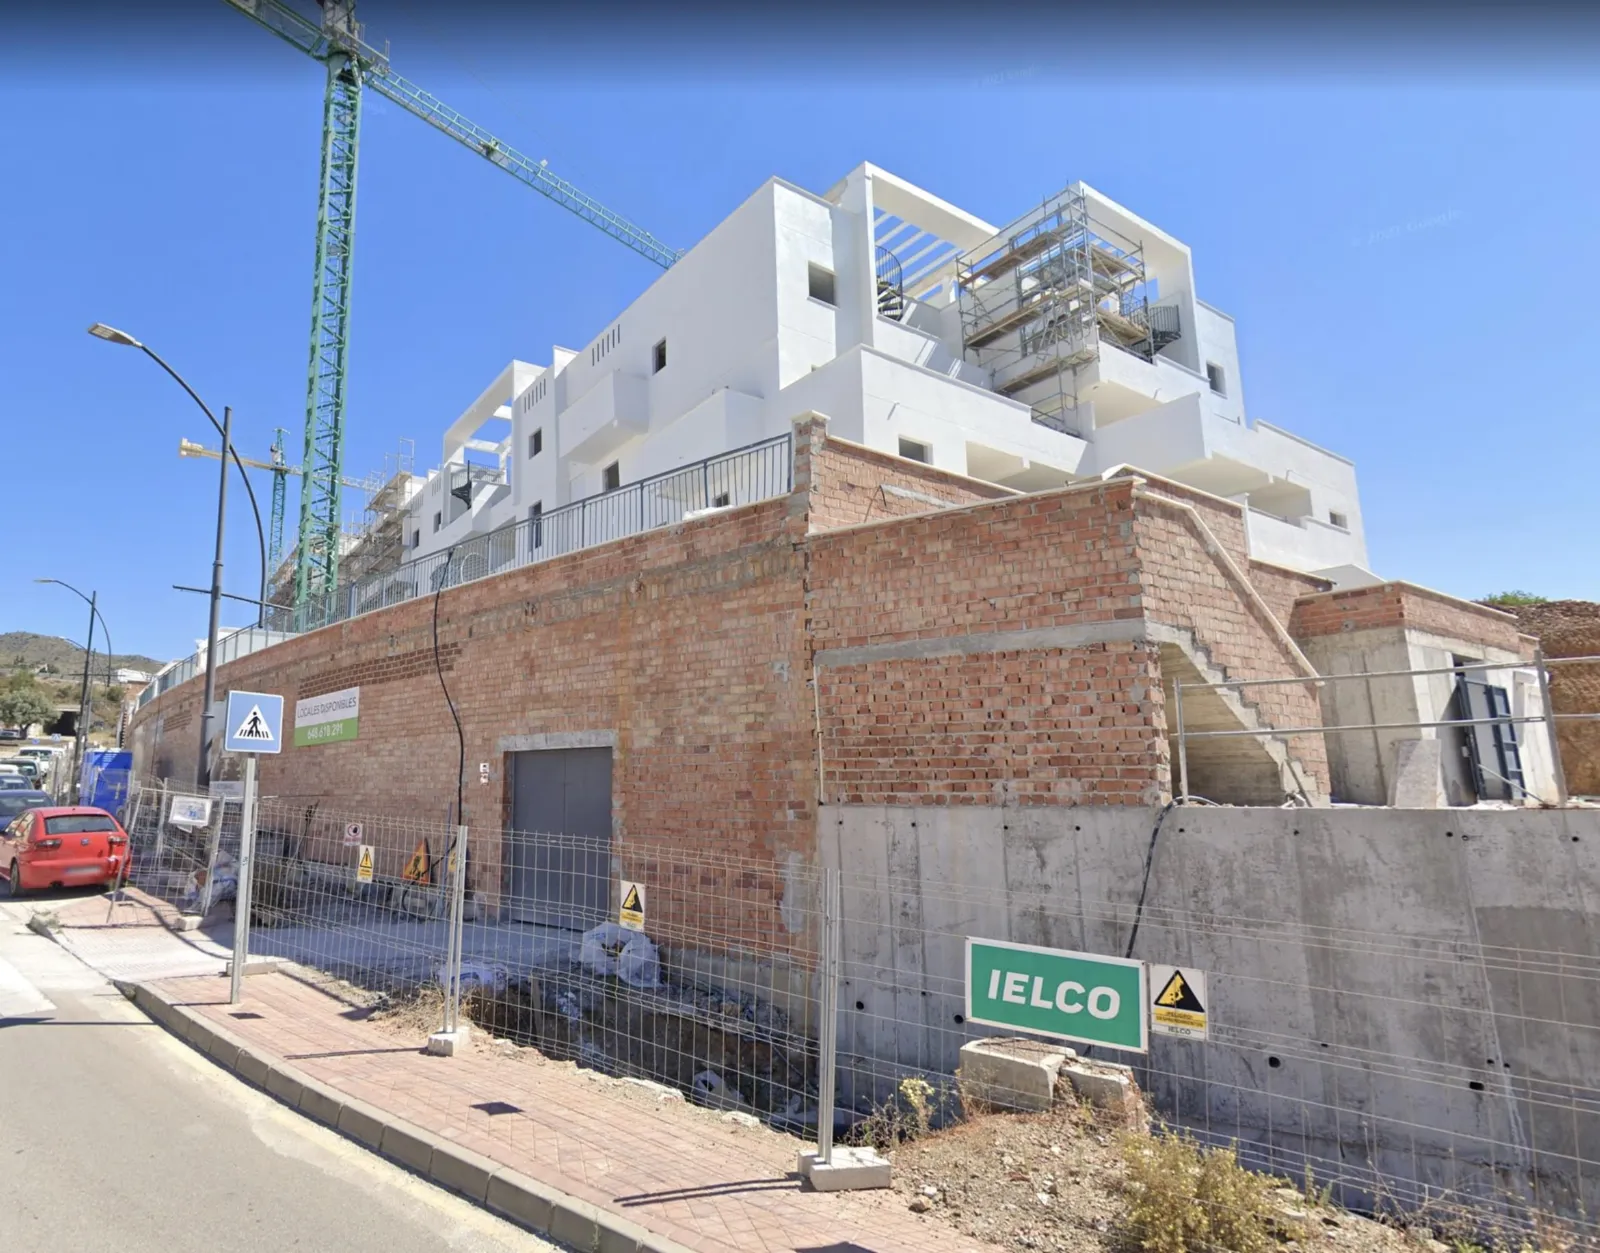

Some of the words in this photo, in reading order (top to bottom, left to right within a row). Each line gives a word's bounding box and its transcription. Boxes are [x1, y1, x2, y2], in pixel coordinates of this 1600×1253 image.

[297, 705, 320, 718] LOCALES
[320, 697, 357, 714] DISPONIBLES
[988, 969, 1121, 1020] IELCO
[1168, 1026, 1191, 1035] IELCO
